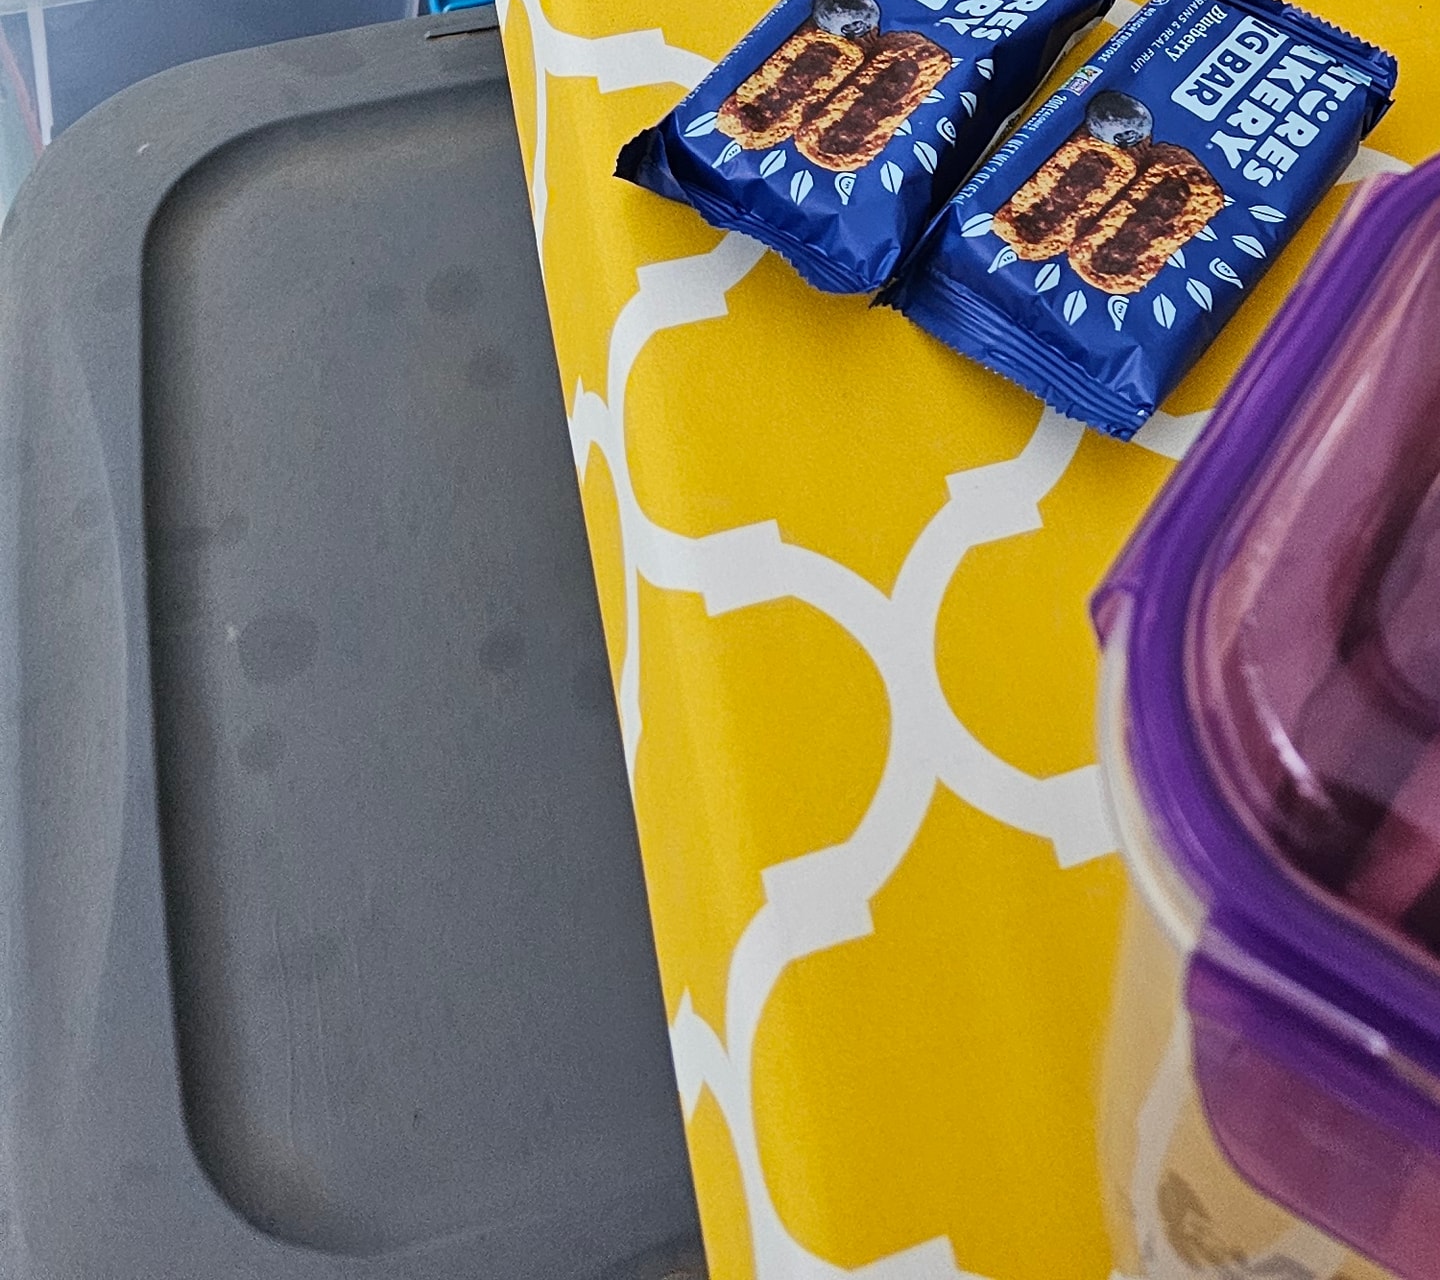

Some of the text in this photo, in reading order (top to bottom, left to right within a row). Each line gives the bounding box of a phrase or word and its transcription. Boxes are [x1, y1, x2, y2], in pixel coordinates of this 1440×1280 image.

[1097, 7, 1157, 63] NO HIGH FRUCTOSE
[1150, 27, 1175, 53] REAL
[1164, 4, 1229, 63] Blueberry
[1130, 50, 1155, 74] FRUIT
[1184, 20, 1281, 108] IG BAR
[1046, 90, 1067, 112] 200
